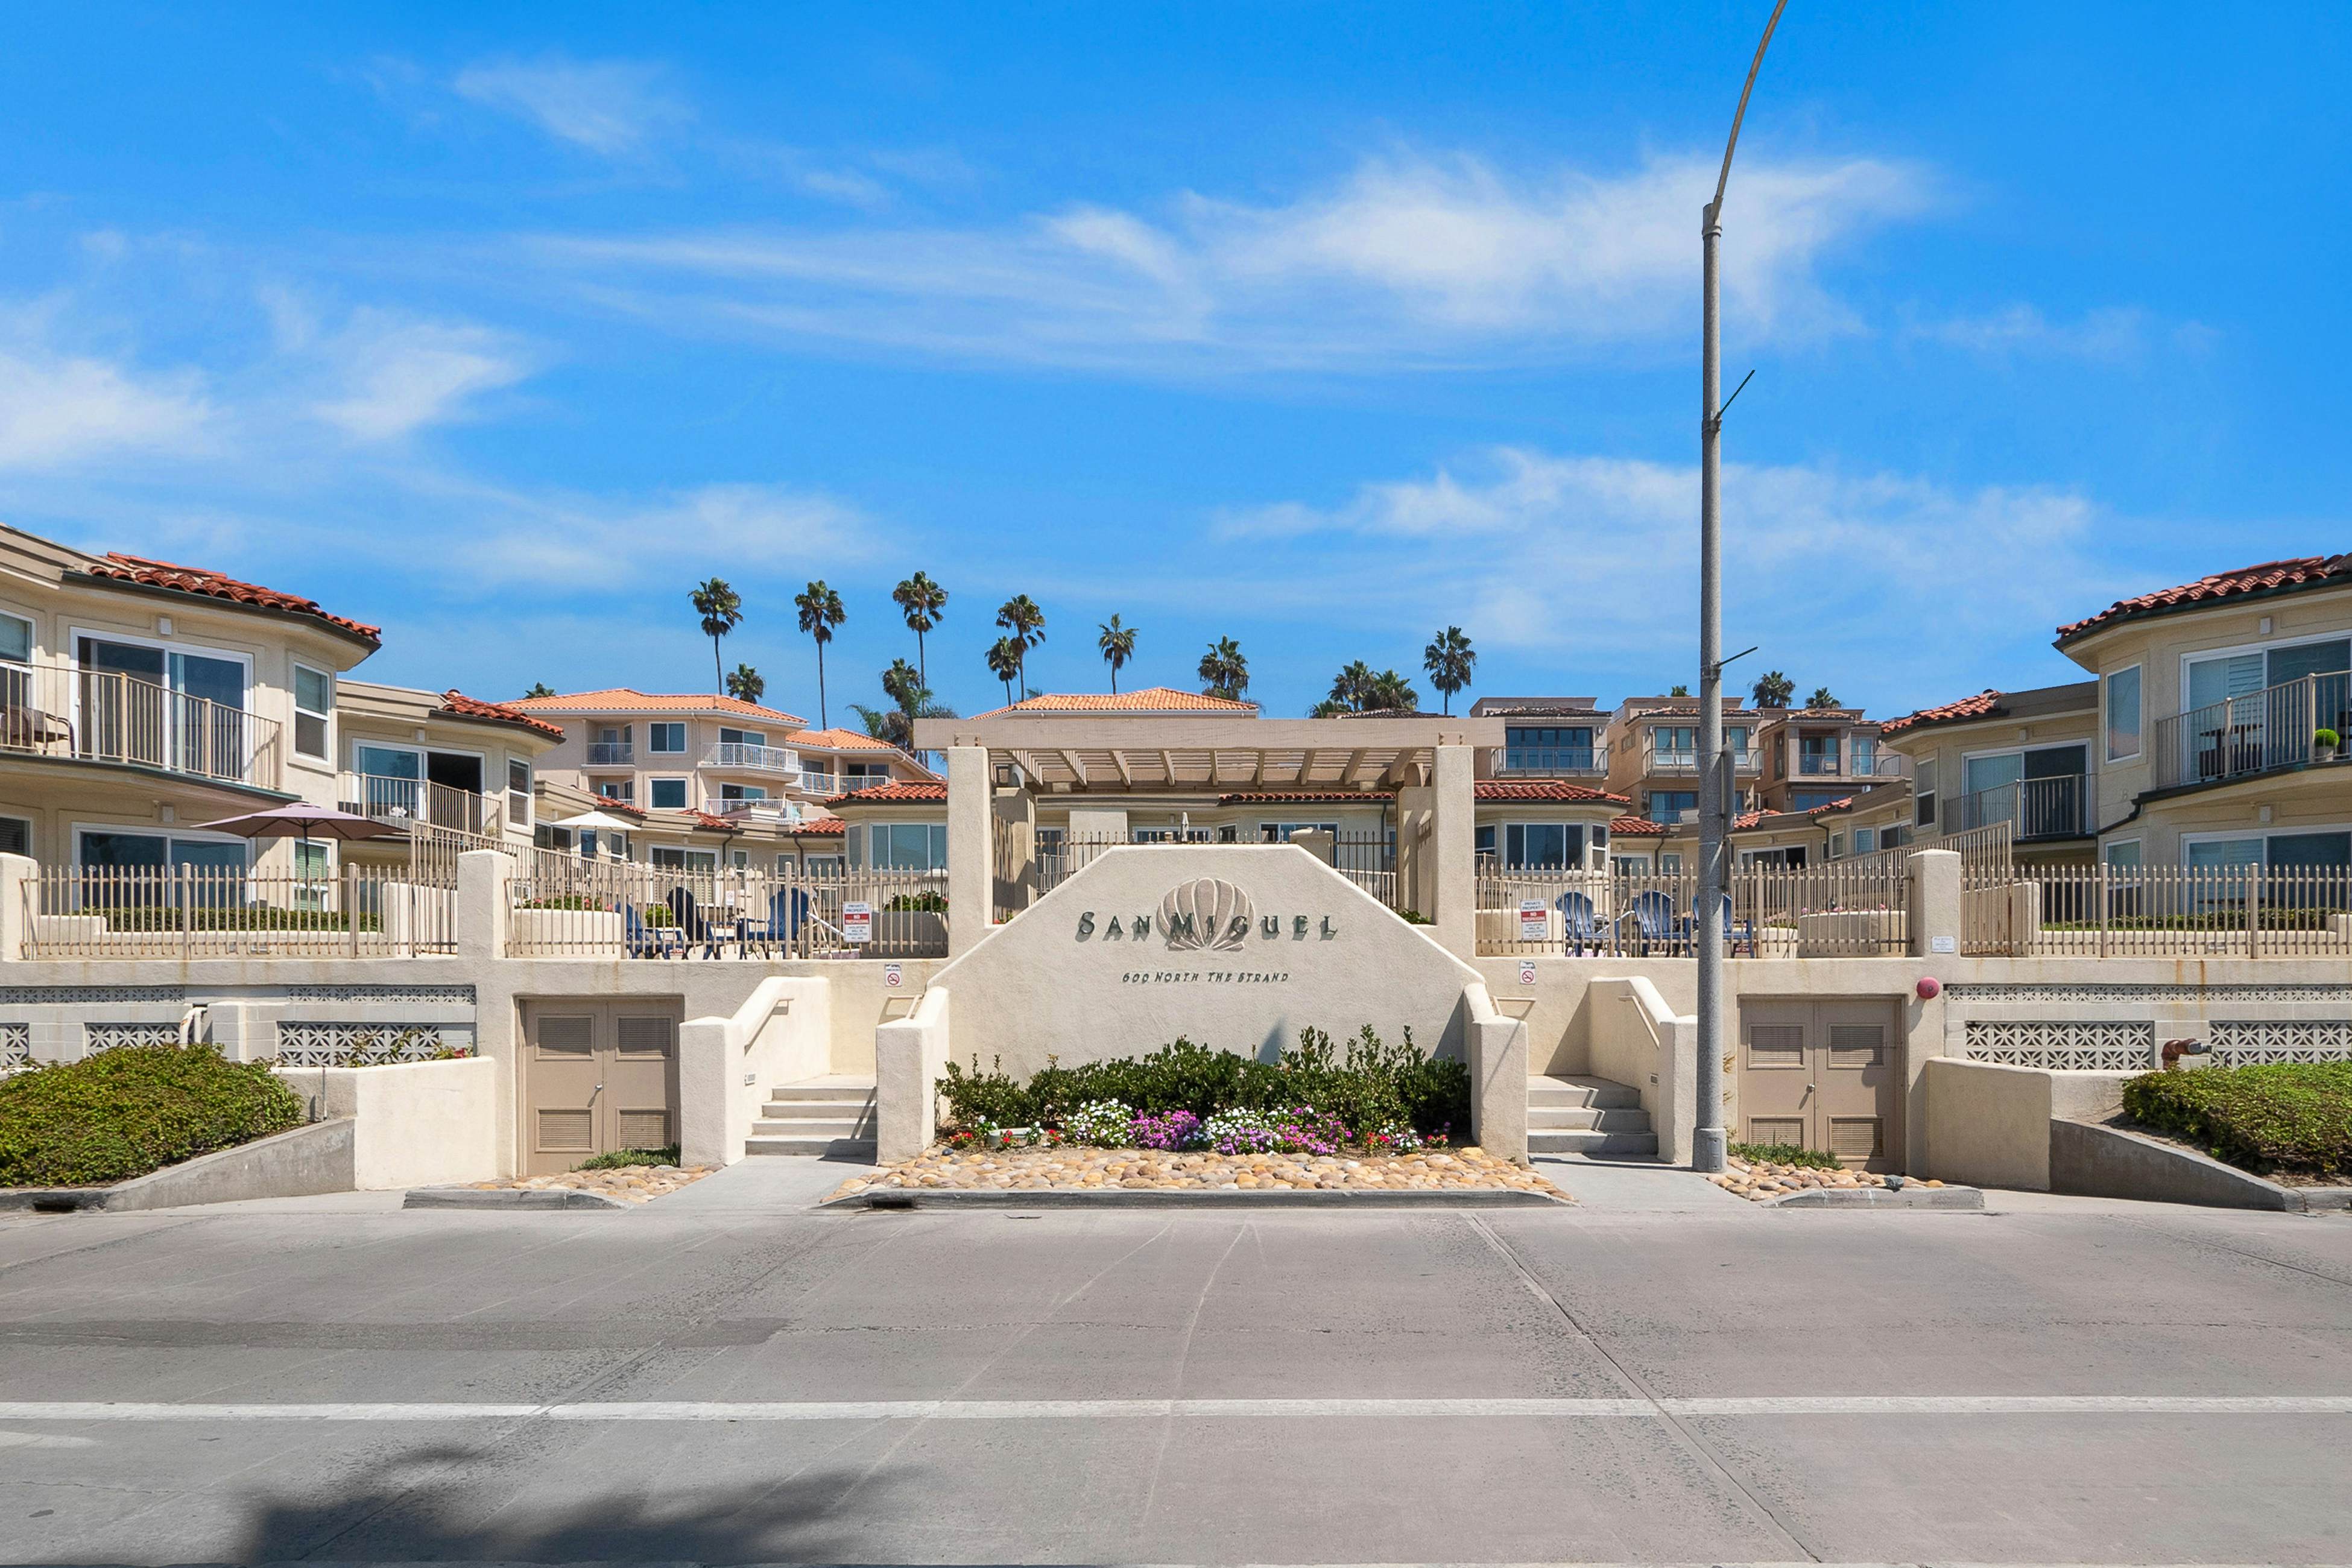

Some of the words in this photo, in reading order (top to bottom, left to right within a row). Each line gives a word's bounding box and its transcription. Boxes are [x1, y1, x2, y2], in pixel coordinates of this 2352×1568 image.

[1080, 911, 1151, 934] SAN
[1170, 912, 1338, 936] MIGUEL
[1122, 972, 1149, 984] 600
[1154, 972, 1199, 982] NORTH
[1208, 972, 1232, 982] THE
[1238, 972, 1289, 983] STRAND
